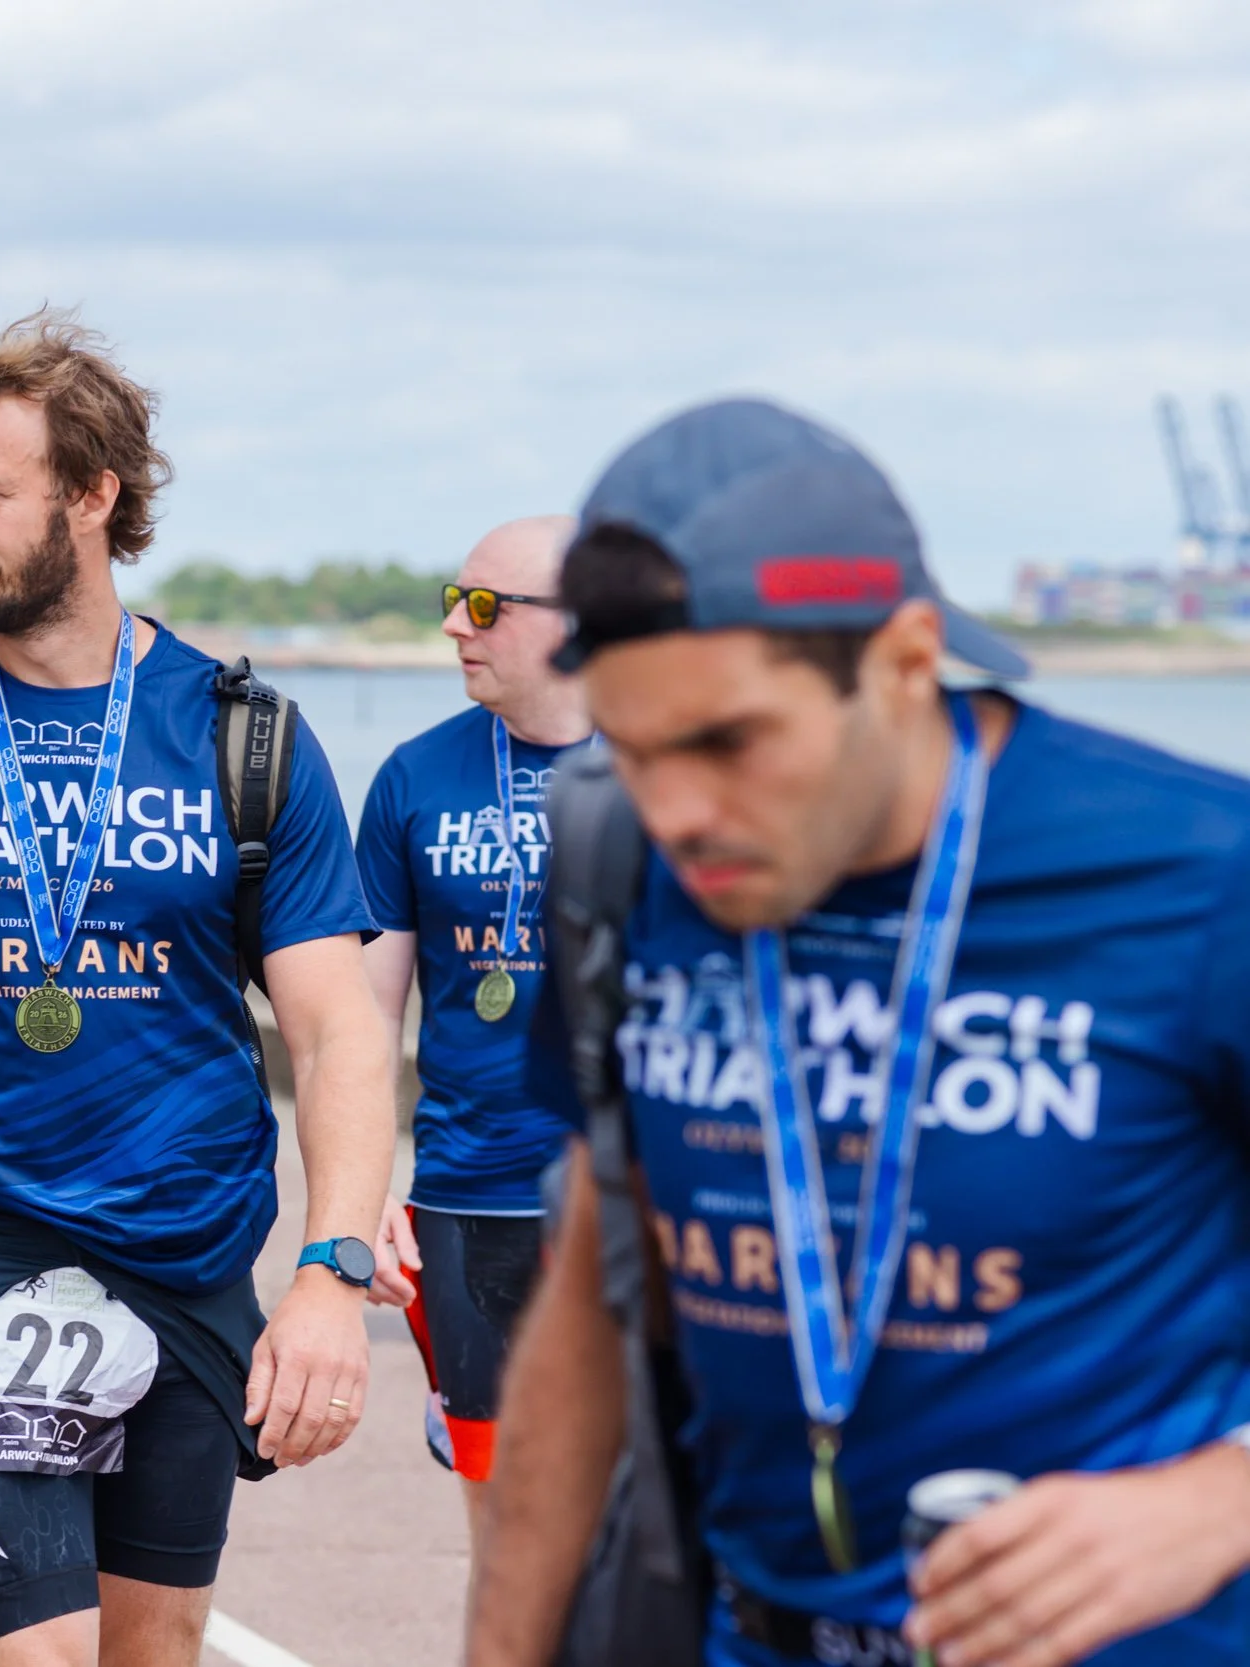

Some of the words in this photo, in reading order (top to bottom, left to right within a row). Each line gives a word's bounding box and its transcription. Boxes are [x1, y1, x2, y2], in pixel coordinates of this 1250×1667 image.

[250, 712, 271, 768] HUUB
[18, 755, 50, 764] WICH
[52, 755, 97, 766] TRIATHL
[425, 844, 548, 876] TRIAT
[92, 878, 114, 892] 26
[110, 921, 125, 931] BY
[26, 989, 71, 1005] HARWICH
[61, 986, 160, 999] ANAGEMENT
[30, 1010, 39, 1018] 20
[58, 1011, 67, 1019] 26
[623, 957, 1095, 1064] HAWCH
[19, 1027, 77, 1050] TRIATHLON
[616, 1022, 1101, 1141] TRIAHON
[656, 1211, 1023, 1313] ARNS
[2, 1312, 104, 1407] 22
